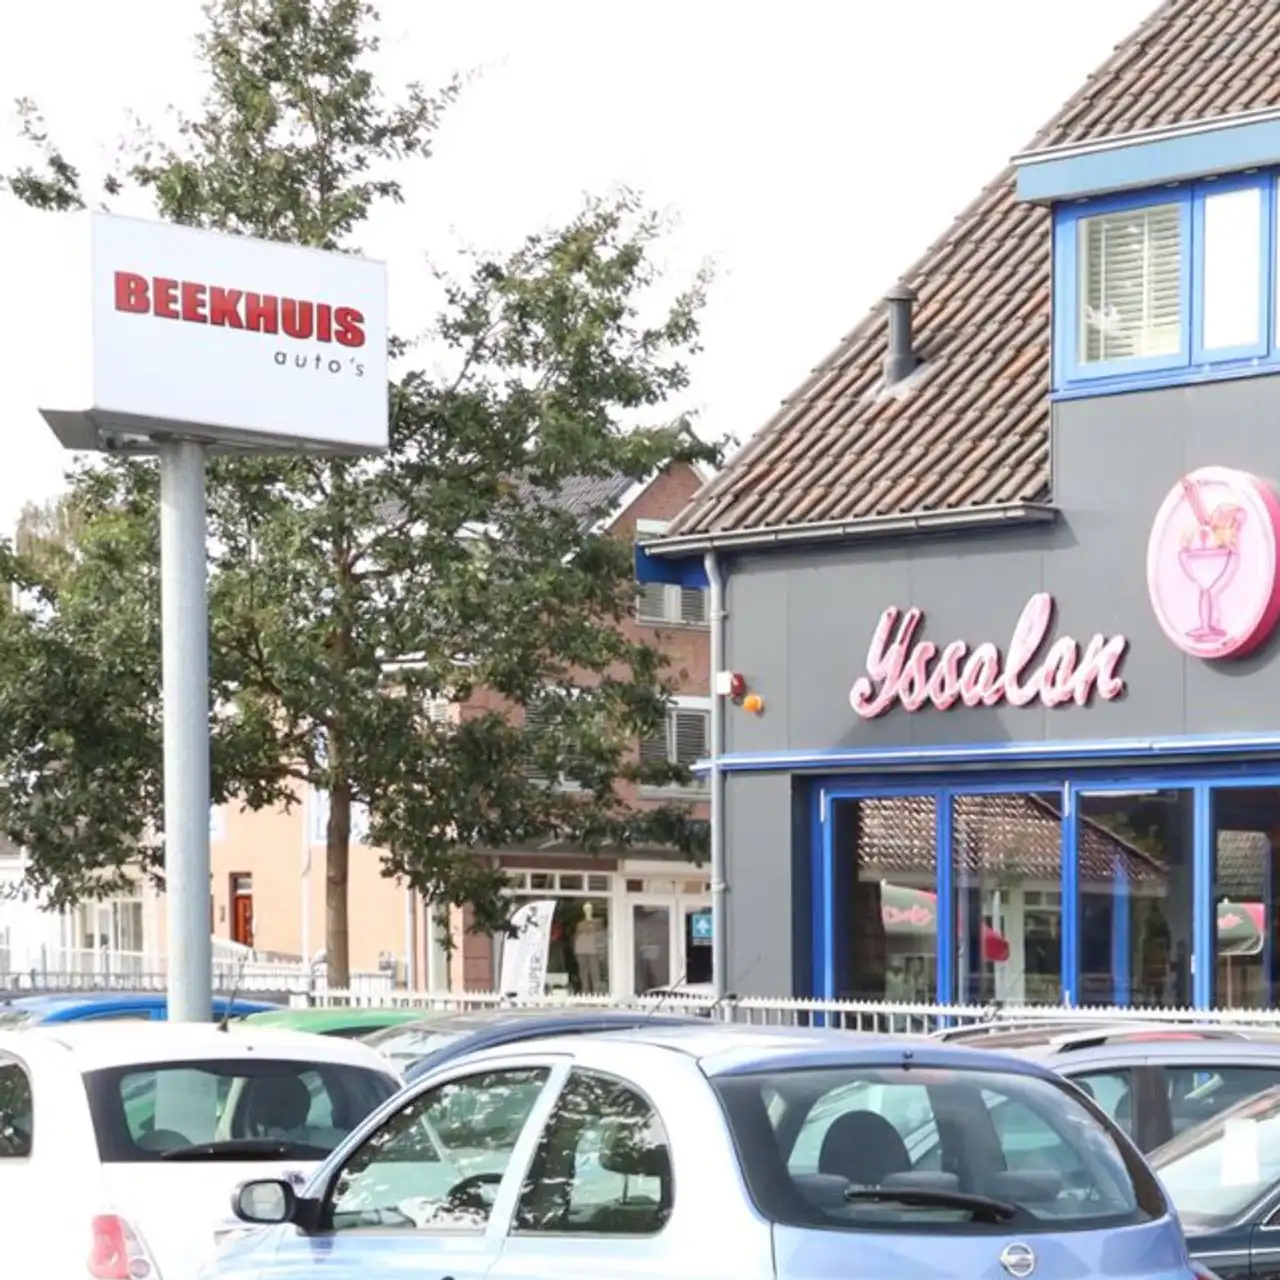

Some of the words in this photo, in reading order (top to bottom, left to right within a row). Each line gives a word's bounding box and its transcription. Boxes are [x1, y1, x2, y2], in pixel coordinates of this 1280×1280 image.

[114, 270, 367, 348] BEEKHUIS
[274, 350, 366, 378] auto's
[850, 592, 1125, 719] Yssalon
